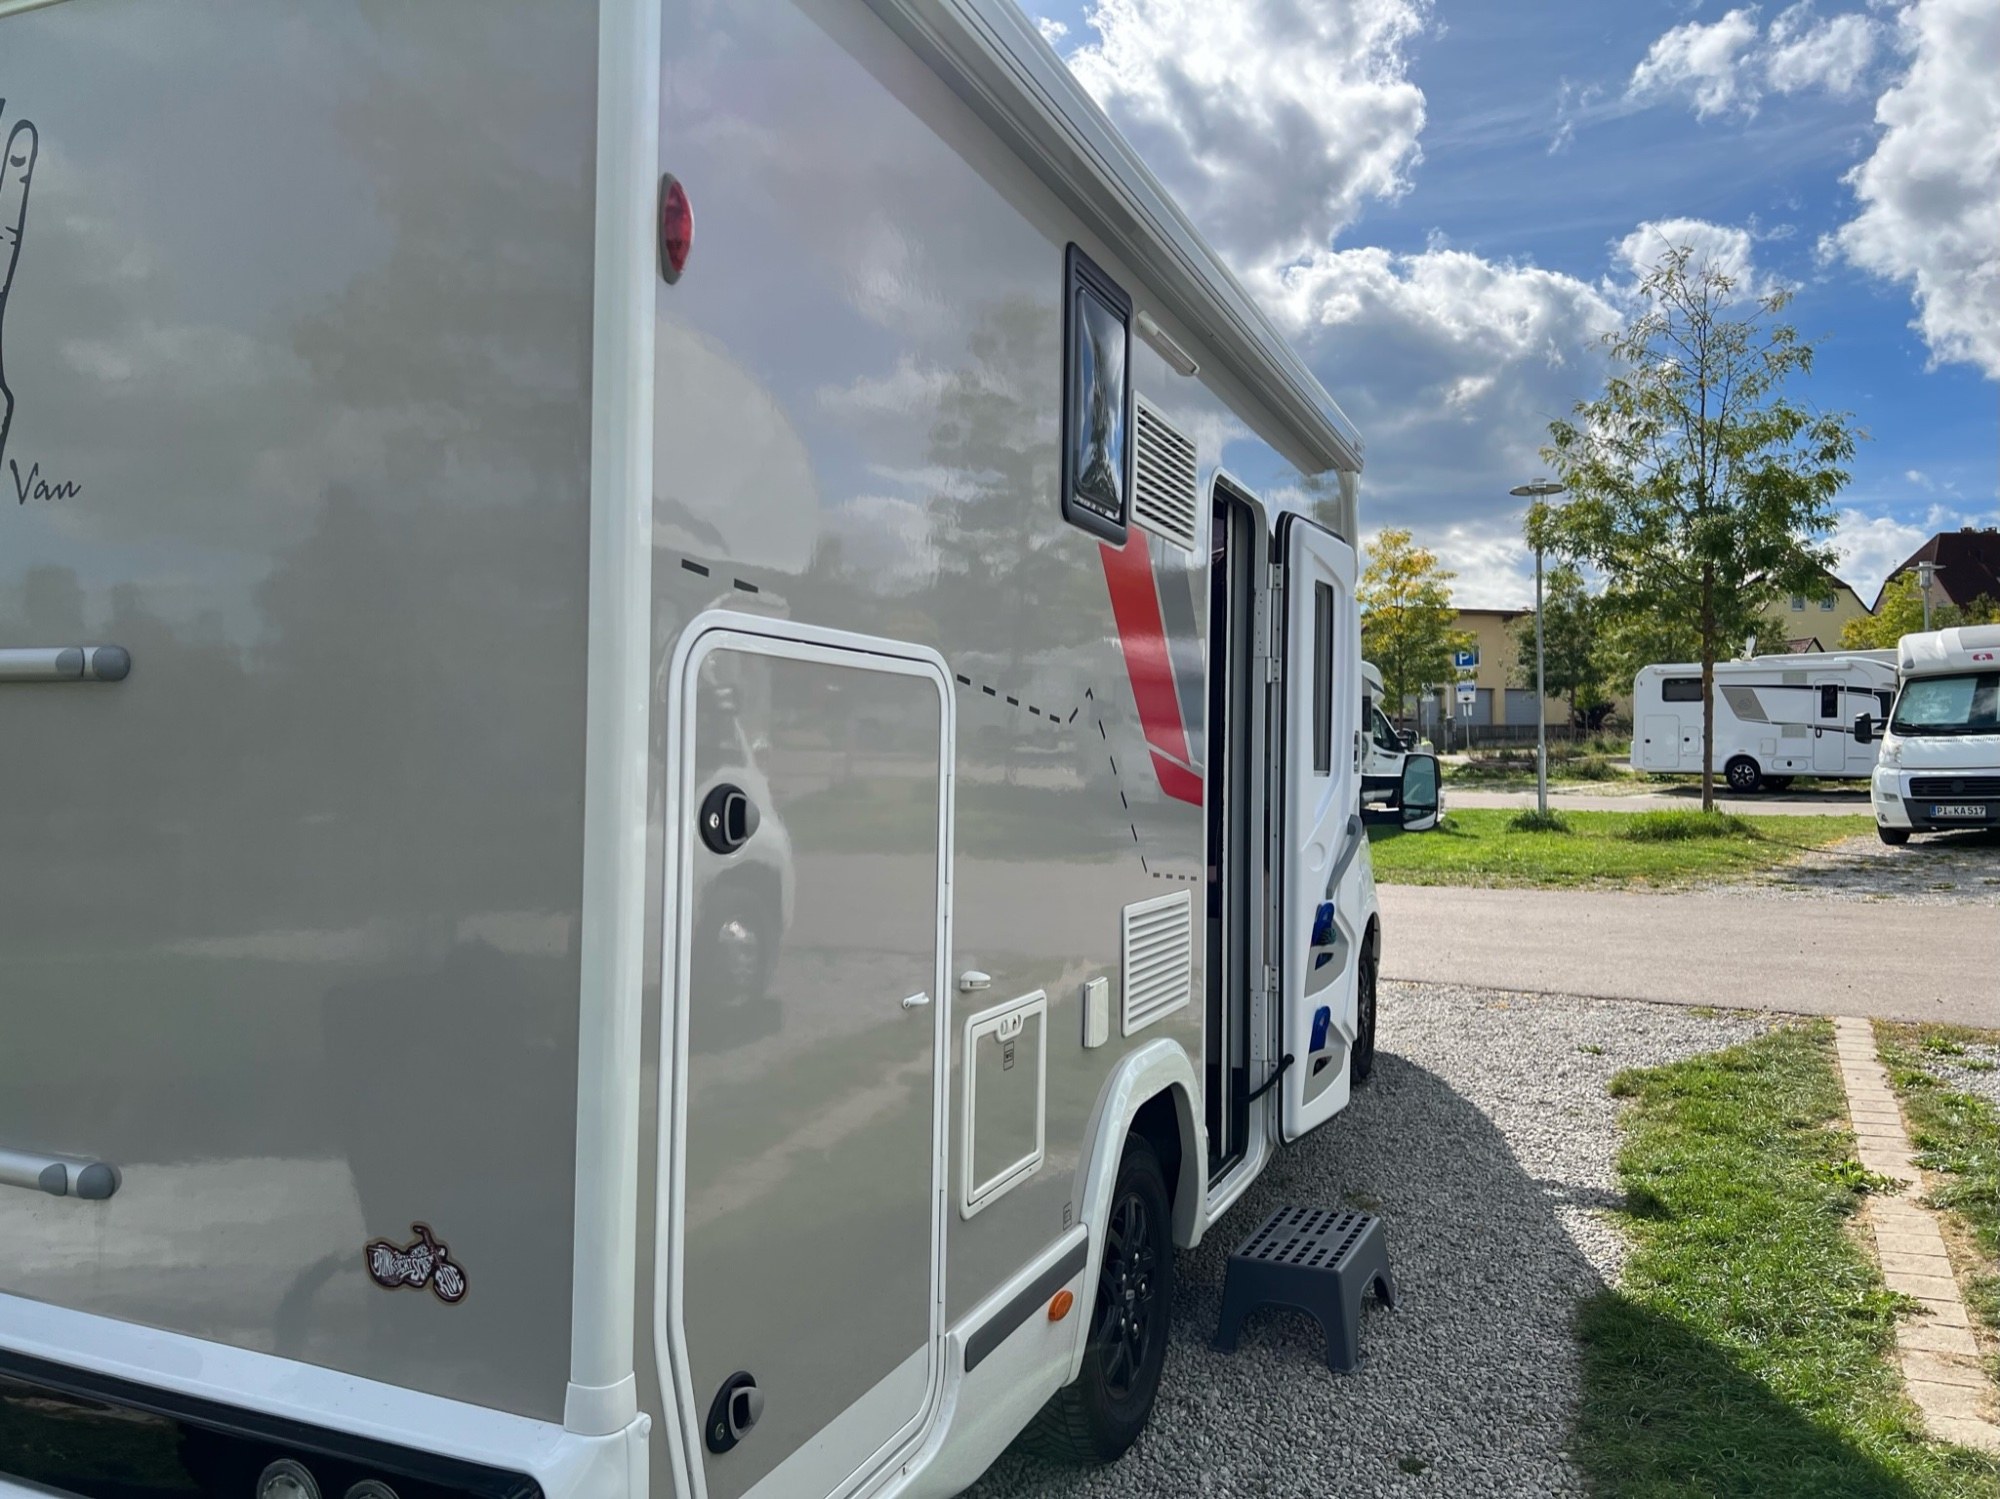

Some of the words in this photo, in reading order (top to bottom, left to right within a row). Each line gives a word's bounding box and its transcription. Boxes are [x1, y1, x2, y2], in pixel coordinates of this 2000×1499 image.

[9, 458, 82, 505] Van
[1459, 651, 1469, 665] P
[435, 1264, 464, 1297] RIDE
